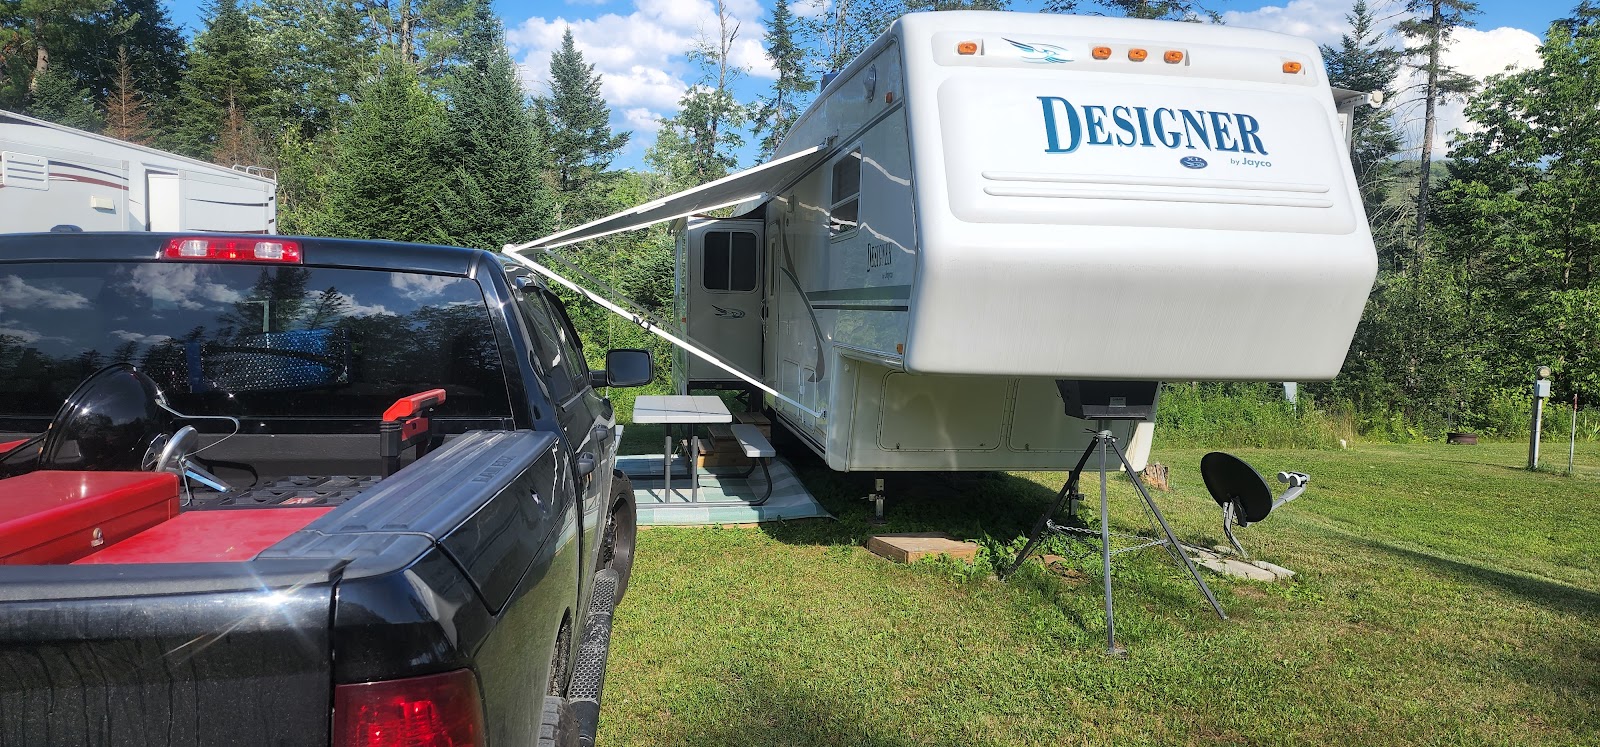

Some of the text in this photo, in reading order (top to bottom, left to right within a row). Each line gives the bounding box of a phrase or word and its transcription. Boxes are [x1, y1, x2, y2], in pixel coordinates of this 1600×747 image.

[1036, 95, 1269, 156] DESIGNER
[1230, 157, 1272, 168] by Jayco
